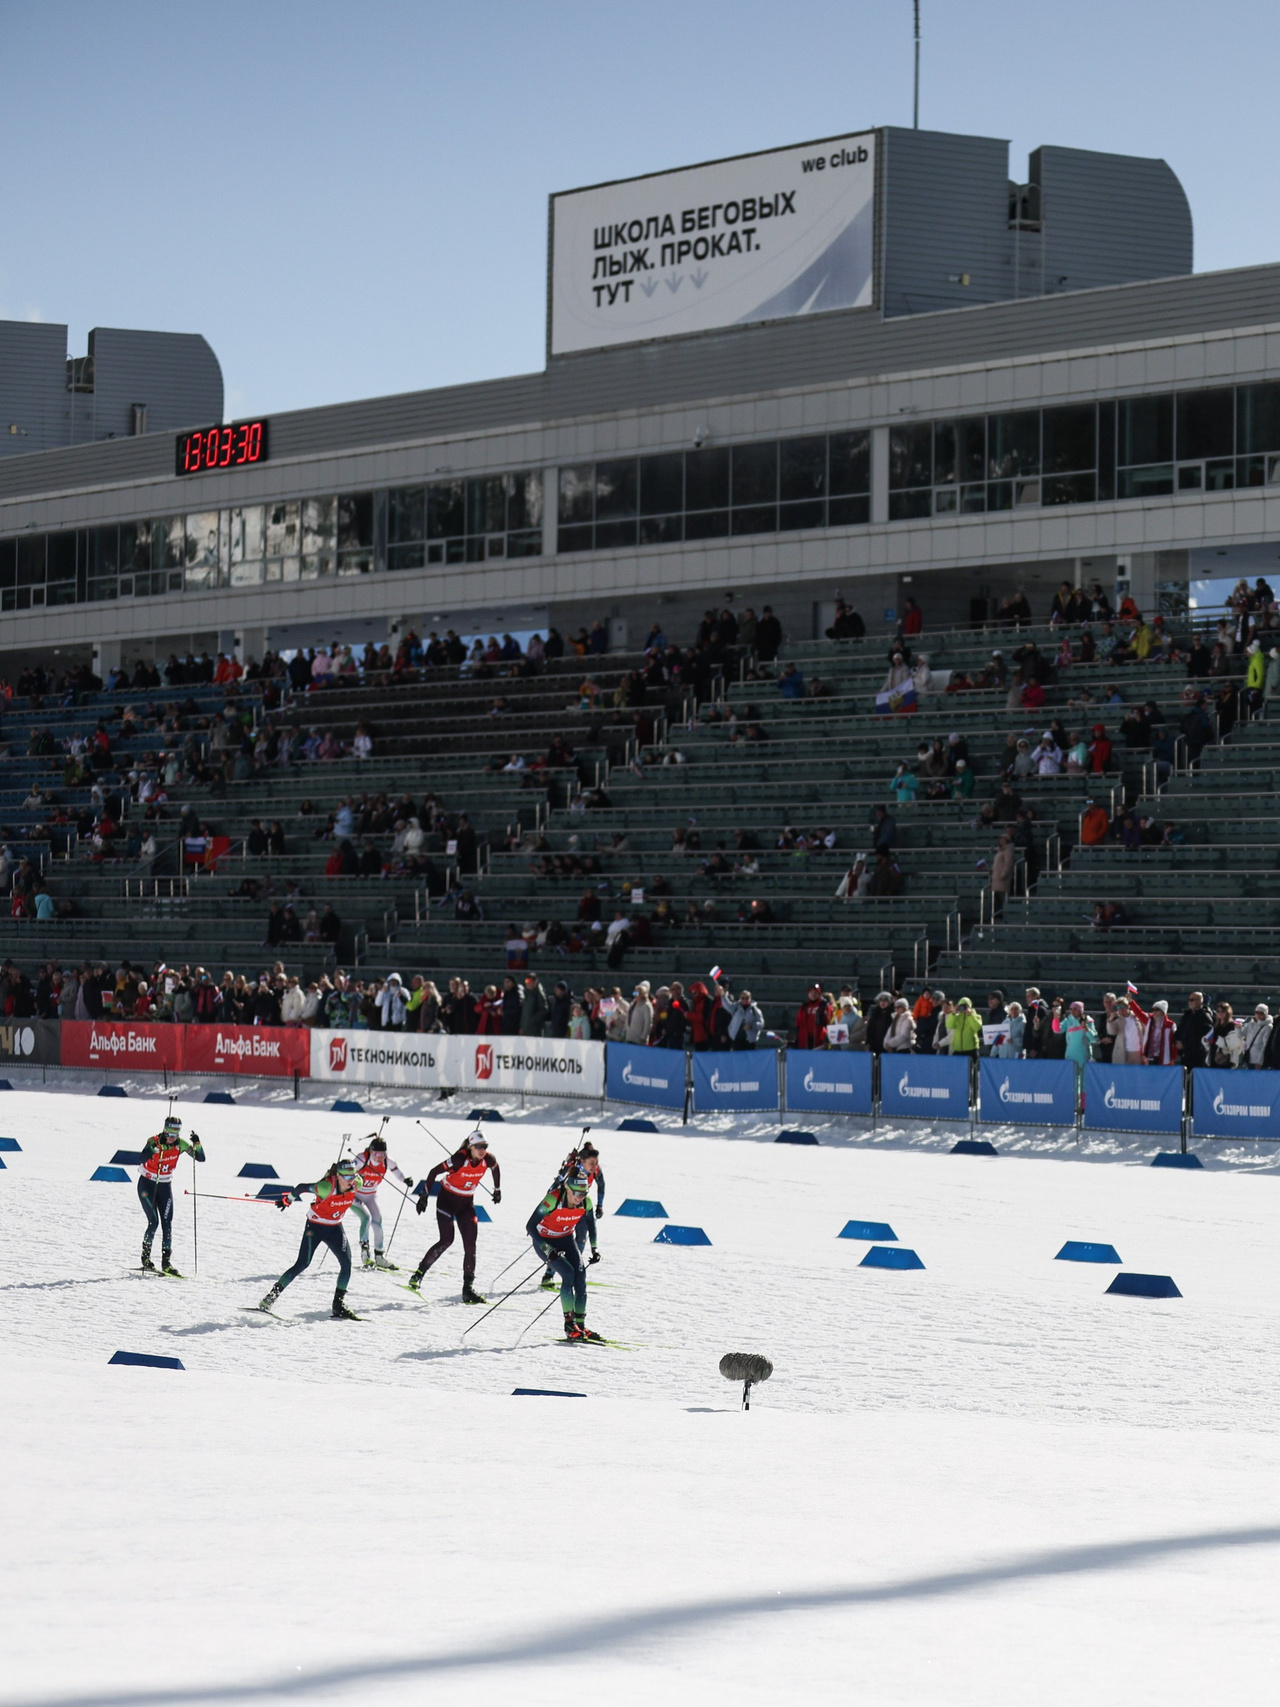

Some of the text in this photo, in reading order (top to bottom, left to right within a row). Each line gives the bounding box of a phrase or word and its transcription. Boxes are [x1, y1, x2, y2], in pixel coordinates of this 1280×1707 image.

[802, 145, 869, 173] we club
[593, 190, 798, 250] ШКОЛА БЕГОВЫХ
[592, 227, 761, 280] ЛЫЖ. ПРОКАТ.
[592, 279, 635, 308] ТУТ
[184, 422, 262, 471] 13:03:30
[89, 1030, 156, 1056] Альфа Банк
[214, 1032, 280, 1060] Альфа Банк
[496, 1054, 583, 1074] ТЕХНОНИКОЛЬ
